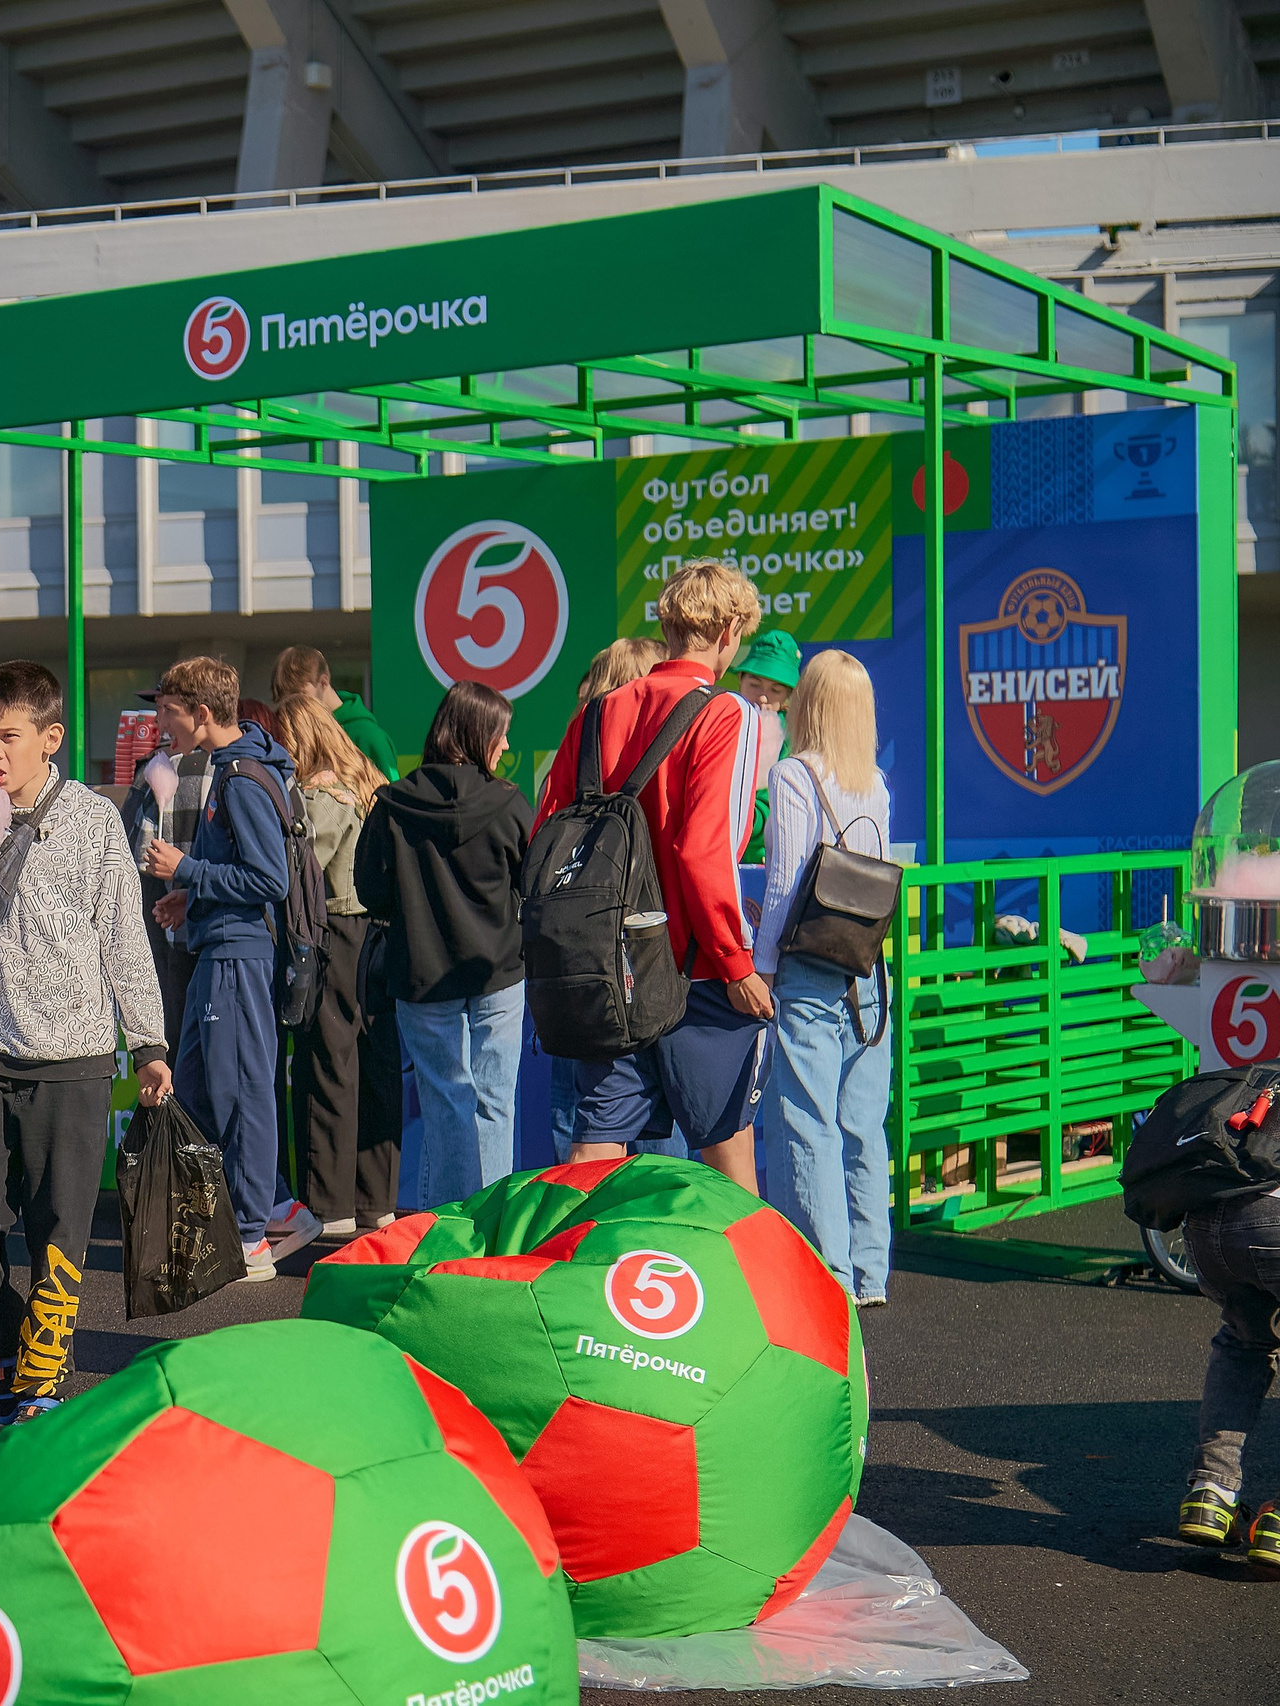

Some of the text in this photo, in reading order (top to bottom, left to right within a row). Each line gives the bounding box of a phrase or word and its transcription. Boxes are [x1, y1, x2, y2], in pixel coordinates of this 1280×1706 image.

[260, 294, 488, 352] Пятёрочка
[643, 469, 770, 509] Футбол
[643, 501, 858, 543] объединяет!
[643, 548, 865, 581] «Пёрочка»
[968, 658, 1120, 704] ЕНИСЕЙ
[575, 1334, 707, 1385] Пятёрочка
